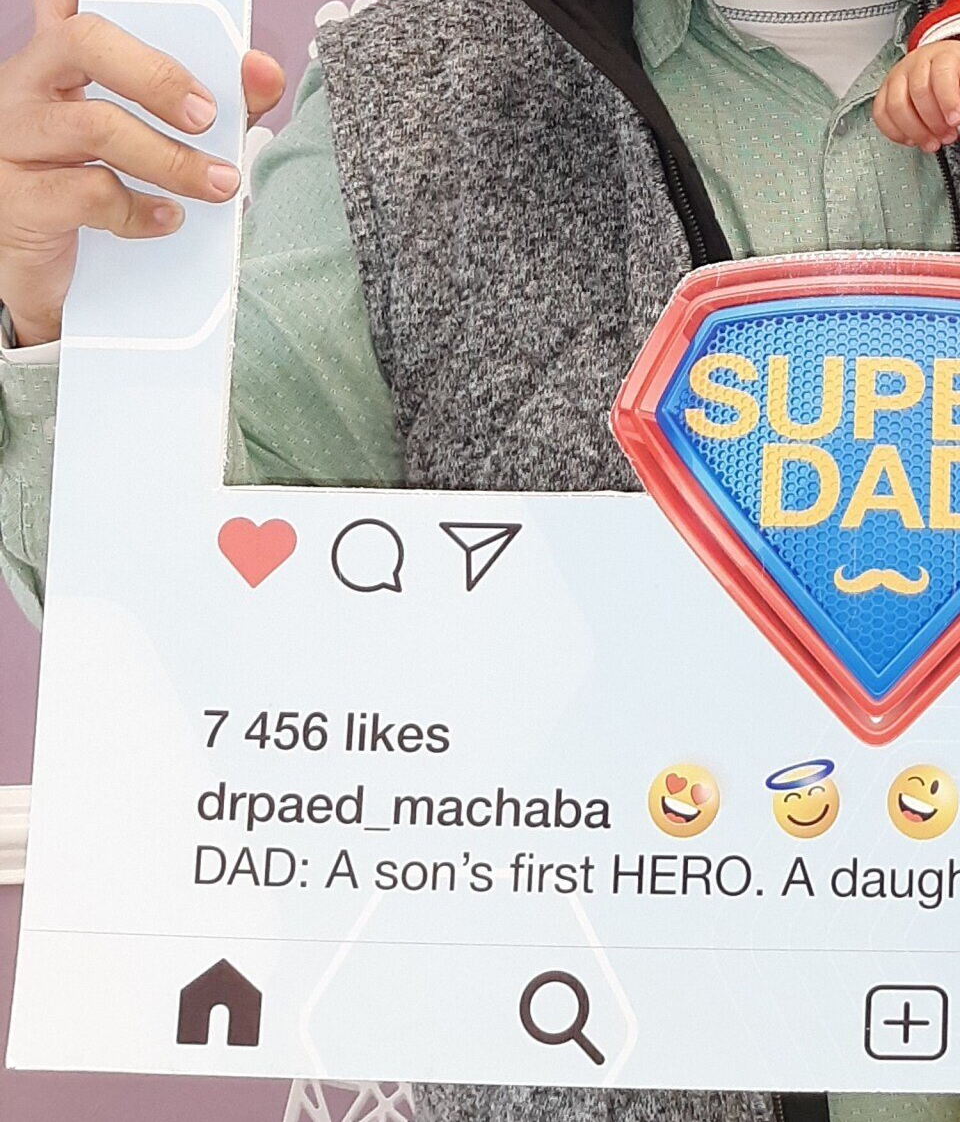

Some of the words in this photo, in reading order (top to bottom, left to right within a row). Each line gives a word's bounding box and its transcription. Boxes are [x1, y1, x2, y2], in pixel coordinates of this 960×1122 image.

[204, 710, 229, 747] 7
[245, 712, 327, 751] 456
[346, 713, 449, 753] likes
[198, 782, 610, 831] drpaed_machaba
[195, 846, 308, 887] DAD:
[325, 850, 358, 888] A
[510, 853, 594, 893] first
[613, 855, 762, 896] HERO.
[782, 857, 814, 896] A
